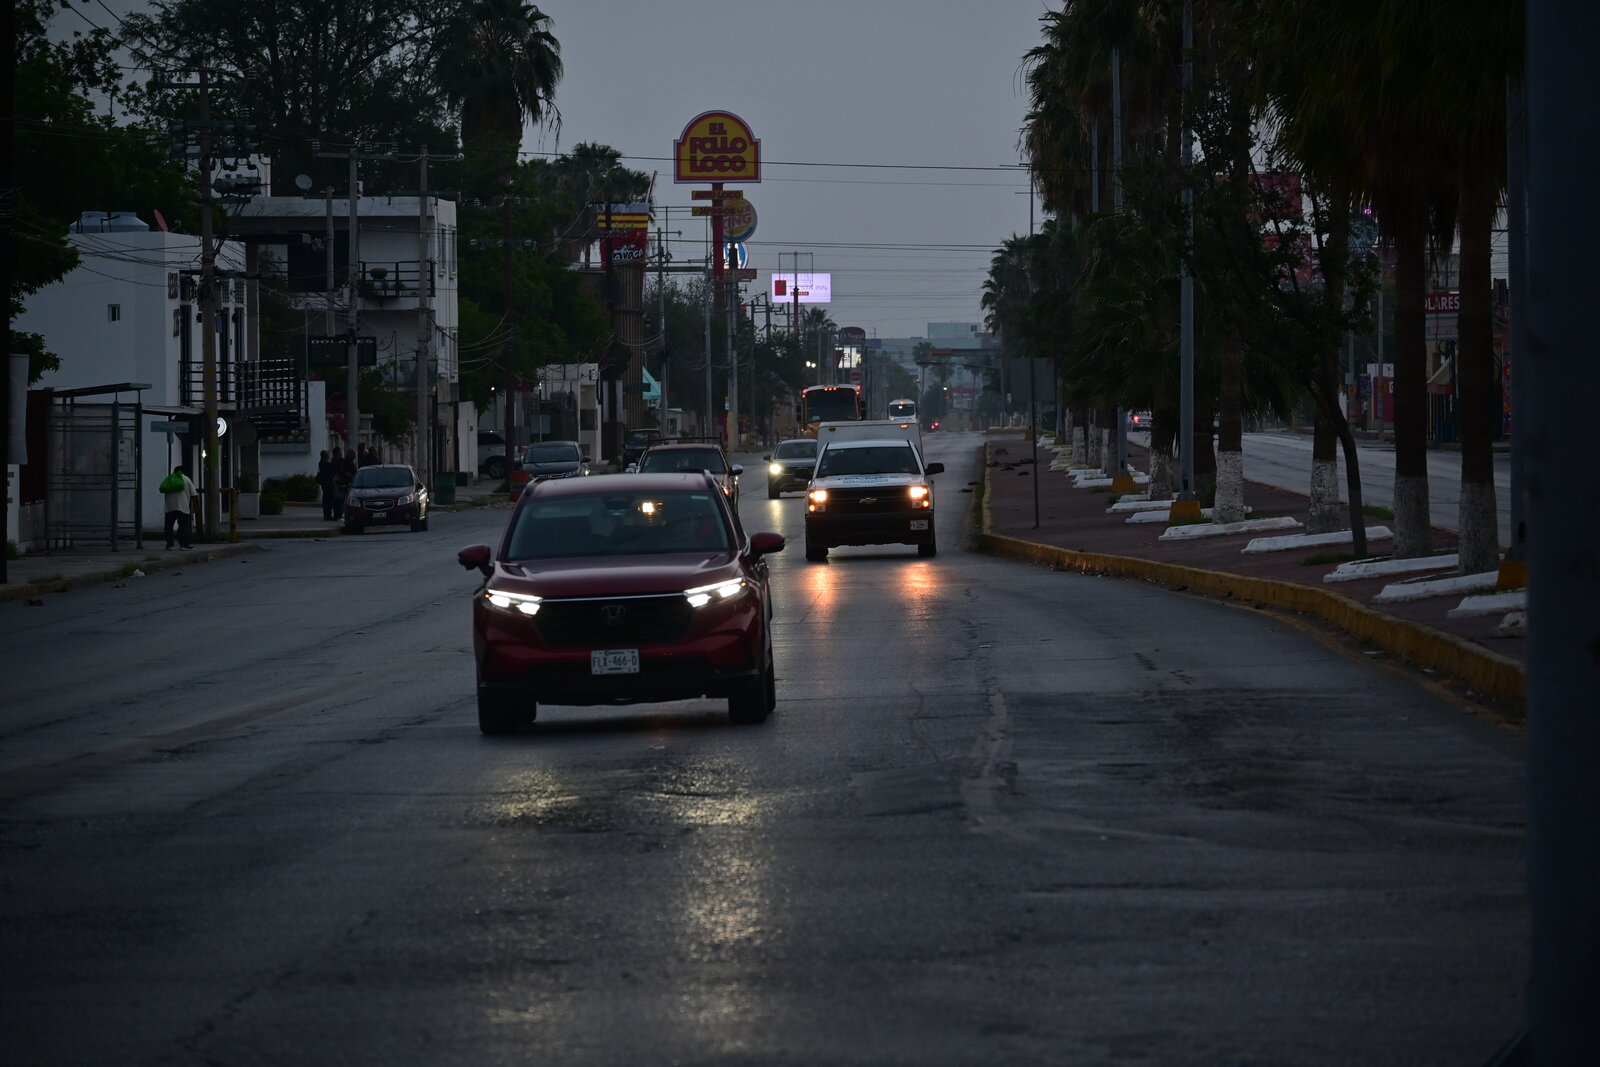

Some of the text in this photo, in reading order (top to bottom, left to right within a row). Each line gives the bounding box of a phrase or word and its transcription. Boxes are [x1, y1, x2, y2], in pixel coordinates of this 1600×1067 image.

[709, 122, 728, 135] EL
[690, 136, 747, 154] POLLO
[690, 155, 746, 172] LOCO
